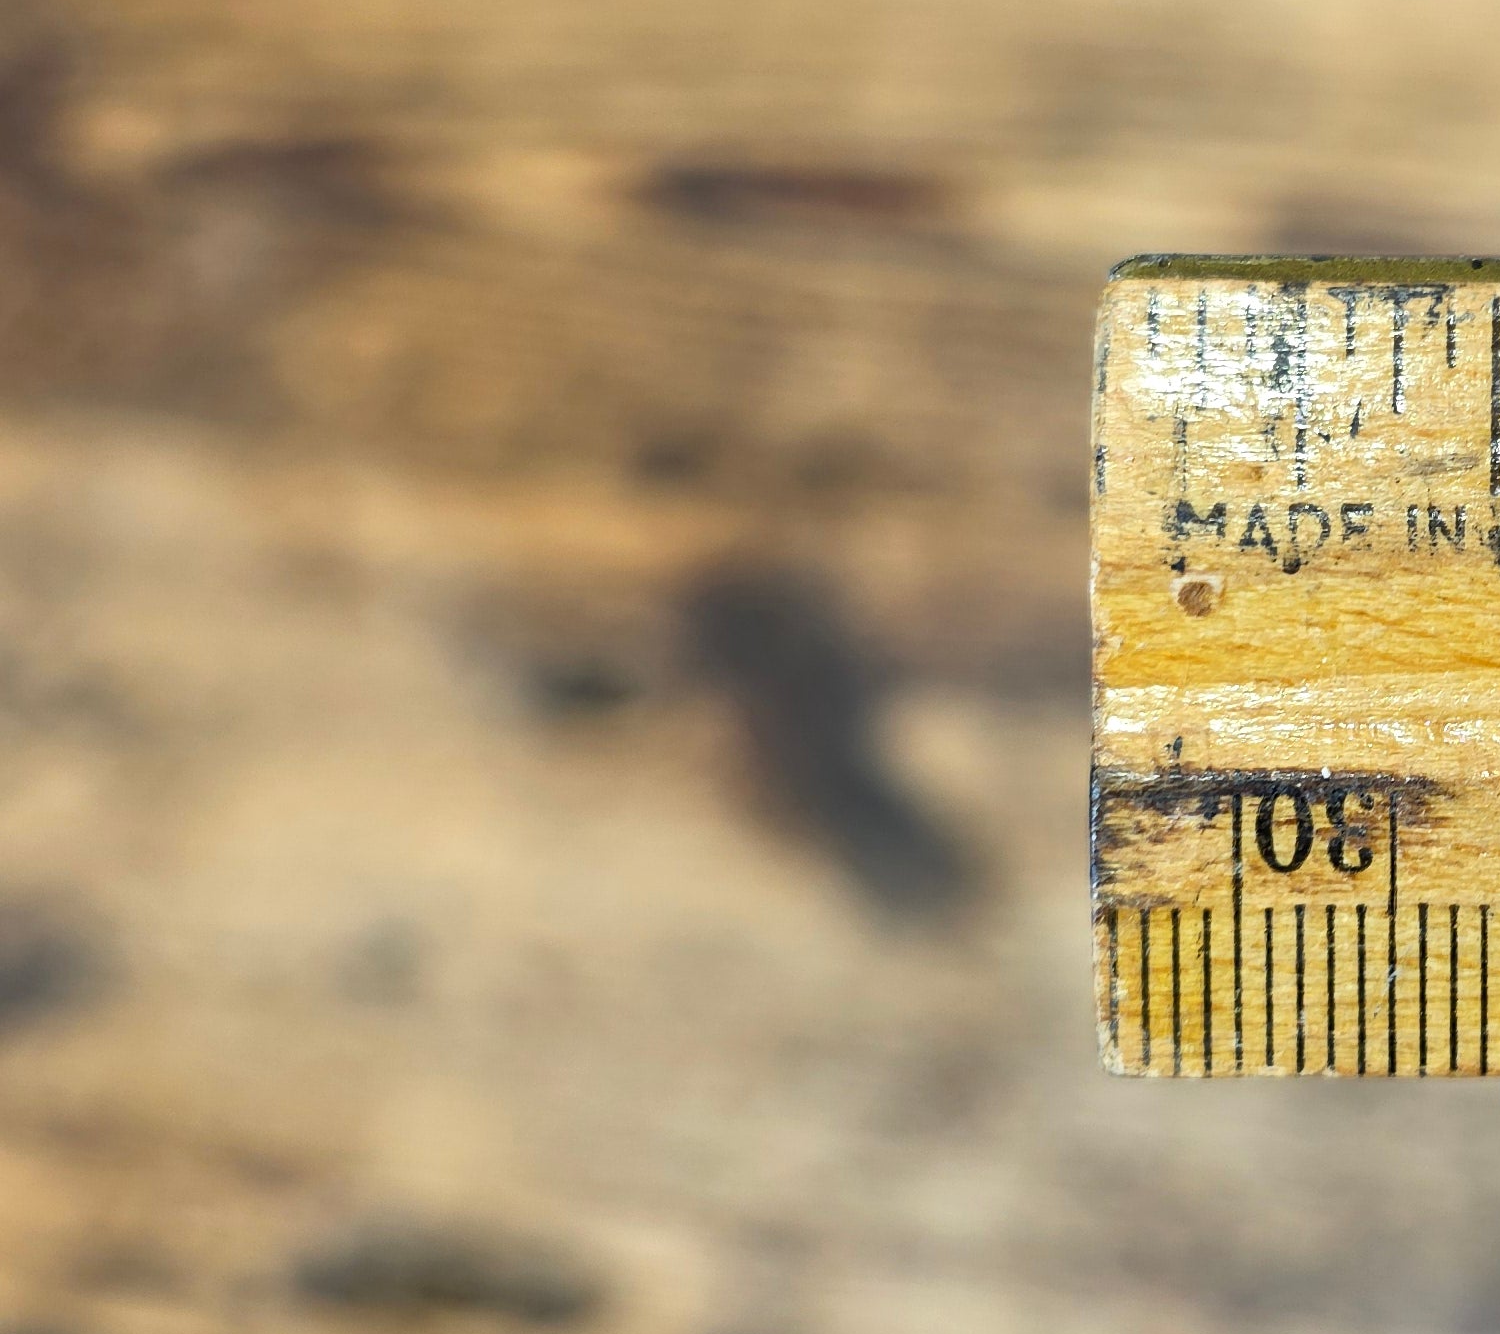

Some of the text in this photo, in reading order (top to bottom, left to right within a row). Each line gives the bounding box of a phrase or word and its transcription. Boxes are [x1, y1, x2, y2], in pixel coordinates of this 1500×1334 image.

[1172, 501, 1374, 555] MADE
[1406, 503, 1466, 553] IN
[1255, 784, 1374, 873] 30
